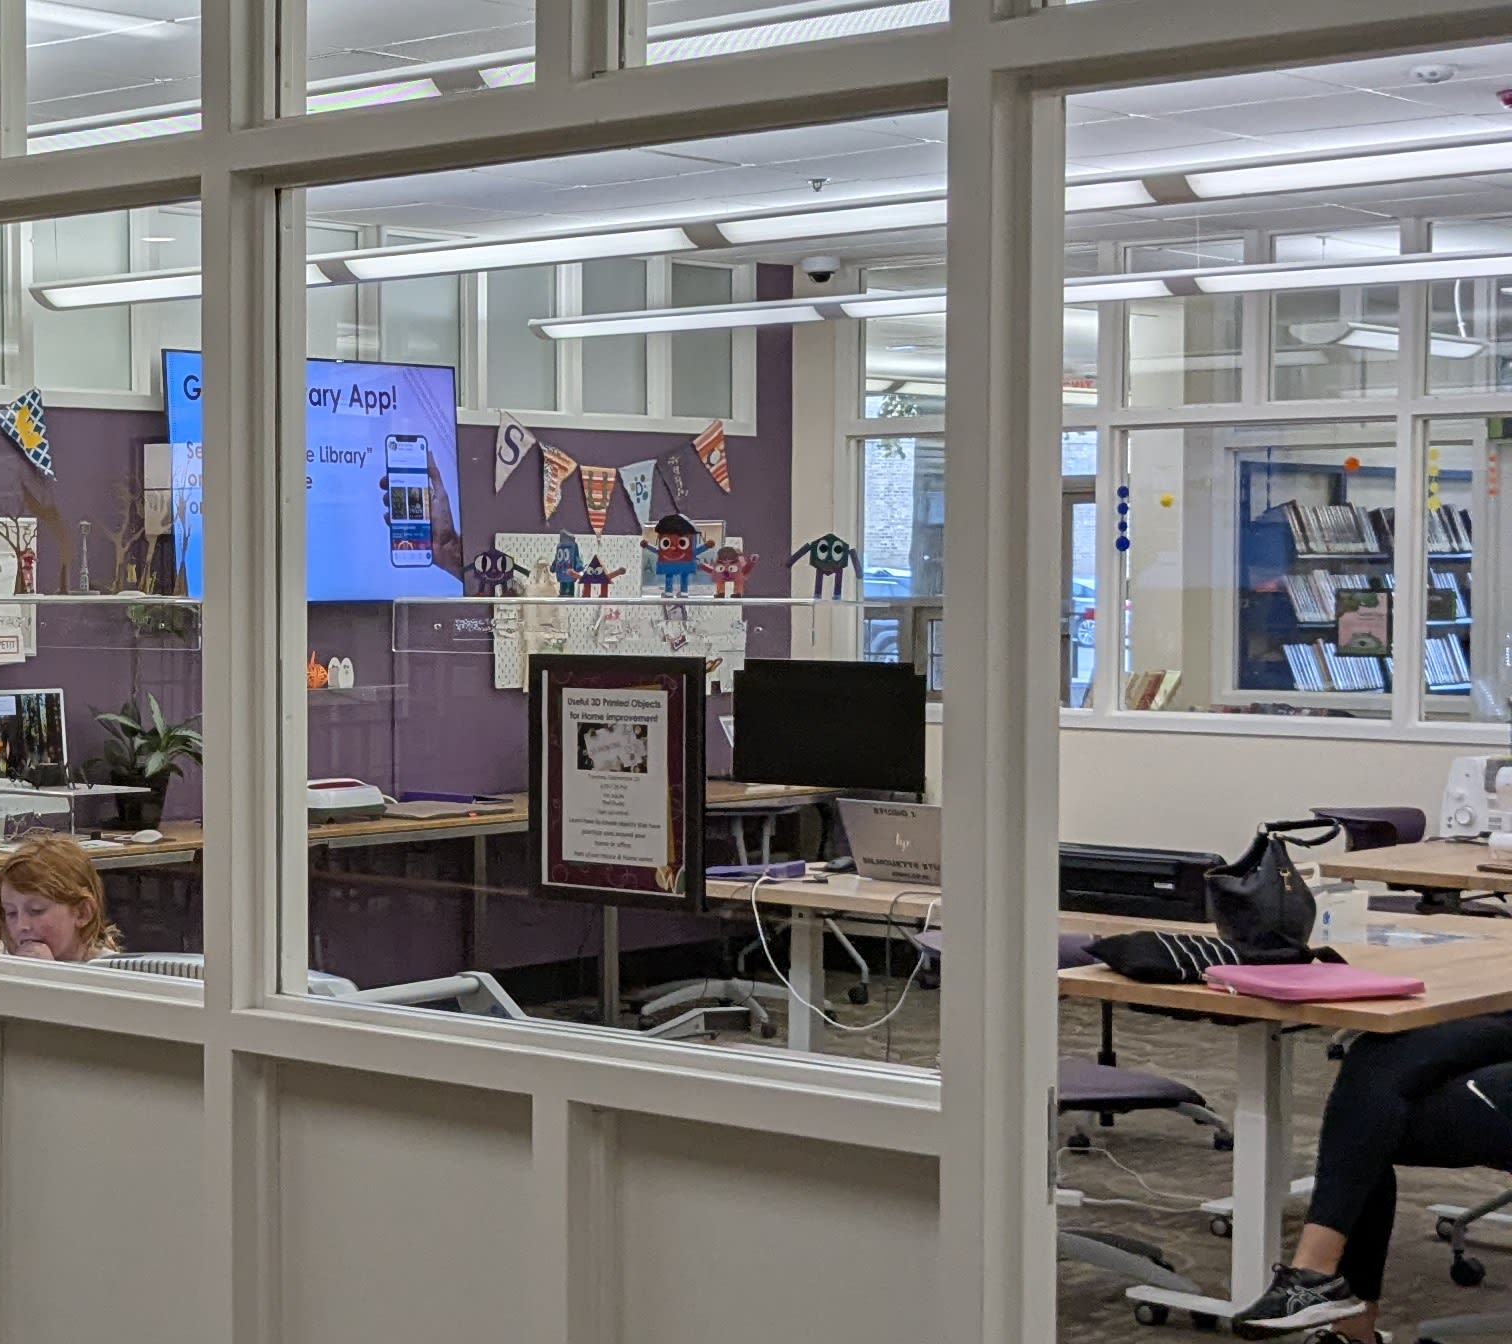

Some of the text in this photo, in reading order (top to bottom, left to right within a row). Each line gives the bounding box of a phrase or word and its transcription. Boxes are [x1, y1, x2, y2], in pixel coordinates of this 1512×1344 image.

[306, 386, 341, 413] ary
[349, 384, 397, 415] App!
[319, 445, 373, 469] Library"
[568, 698, 661, 709] Useful 3D Printed Objects
[582, 712, 604, 721] Home
